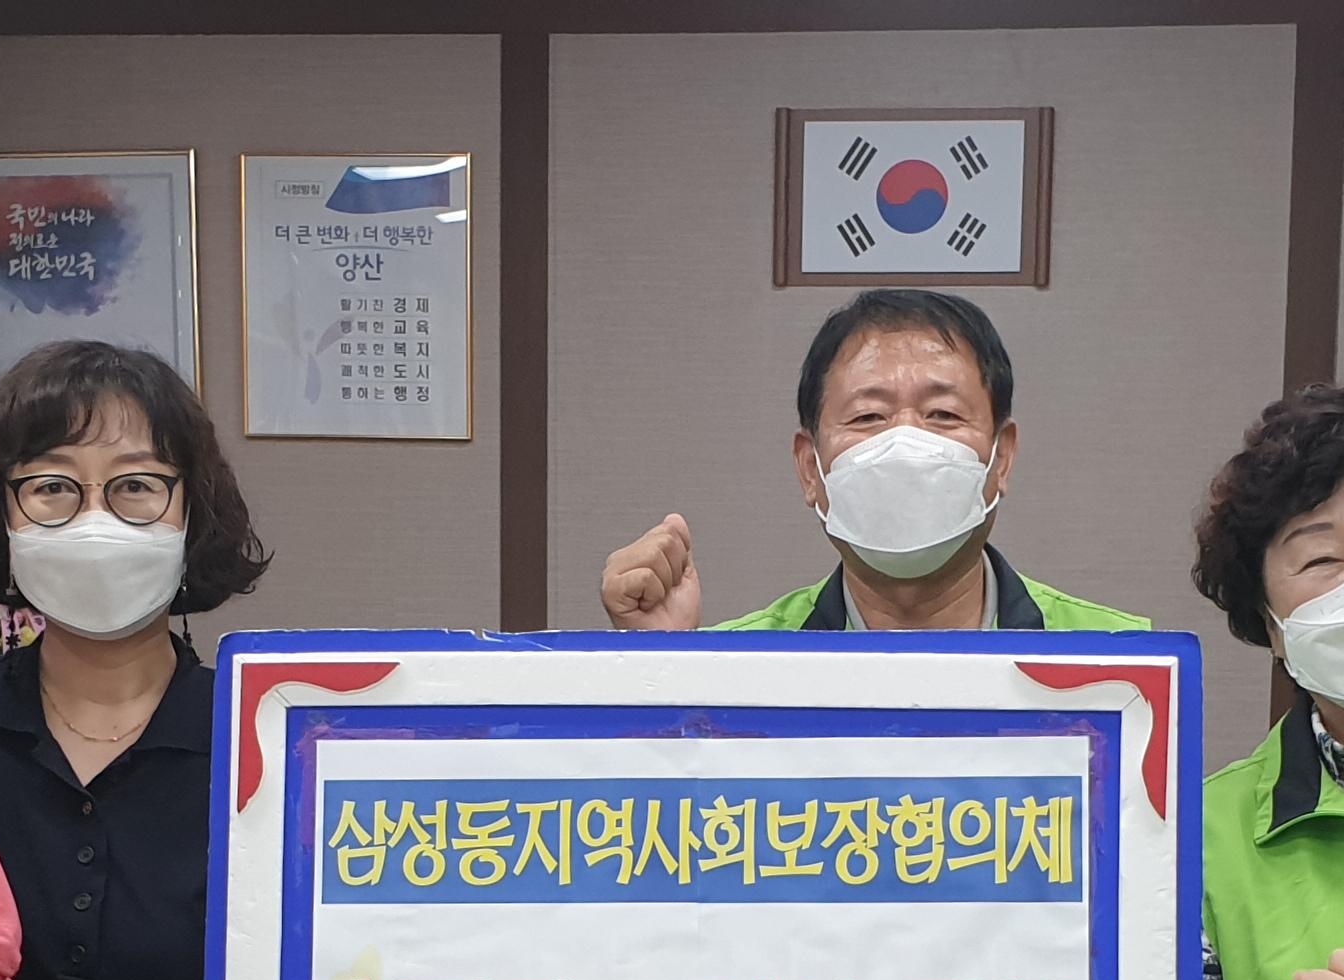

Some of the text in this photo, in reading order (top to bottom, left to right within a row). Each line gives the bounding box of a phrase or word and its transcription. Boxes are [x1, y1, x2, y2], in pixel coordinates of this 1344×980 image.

[6, 203, 96, 230] 국민의 나라
[8, 233, 59, 251] 정의로운
[274, 225, 434, 247] 더 큰 변화 더 행복한
[8, 252, 97, 280] 대한민국
[335, 252, 385, 282] 양산
[327, 793, 1074, 887] 삼성동지역사회보장협의체
